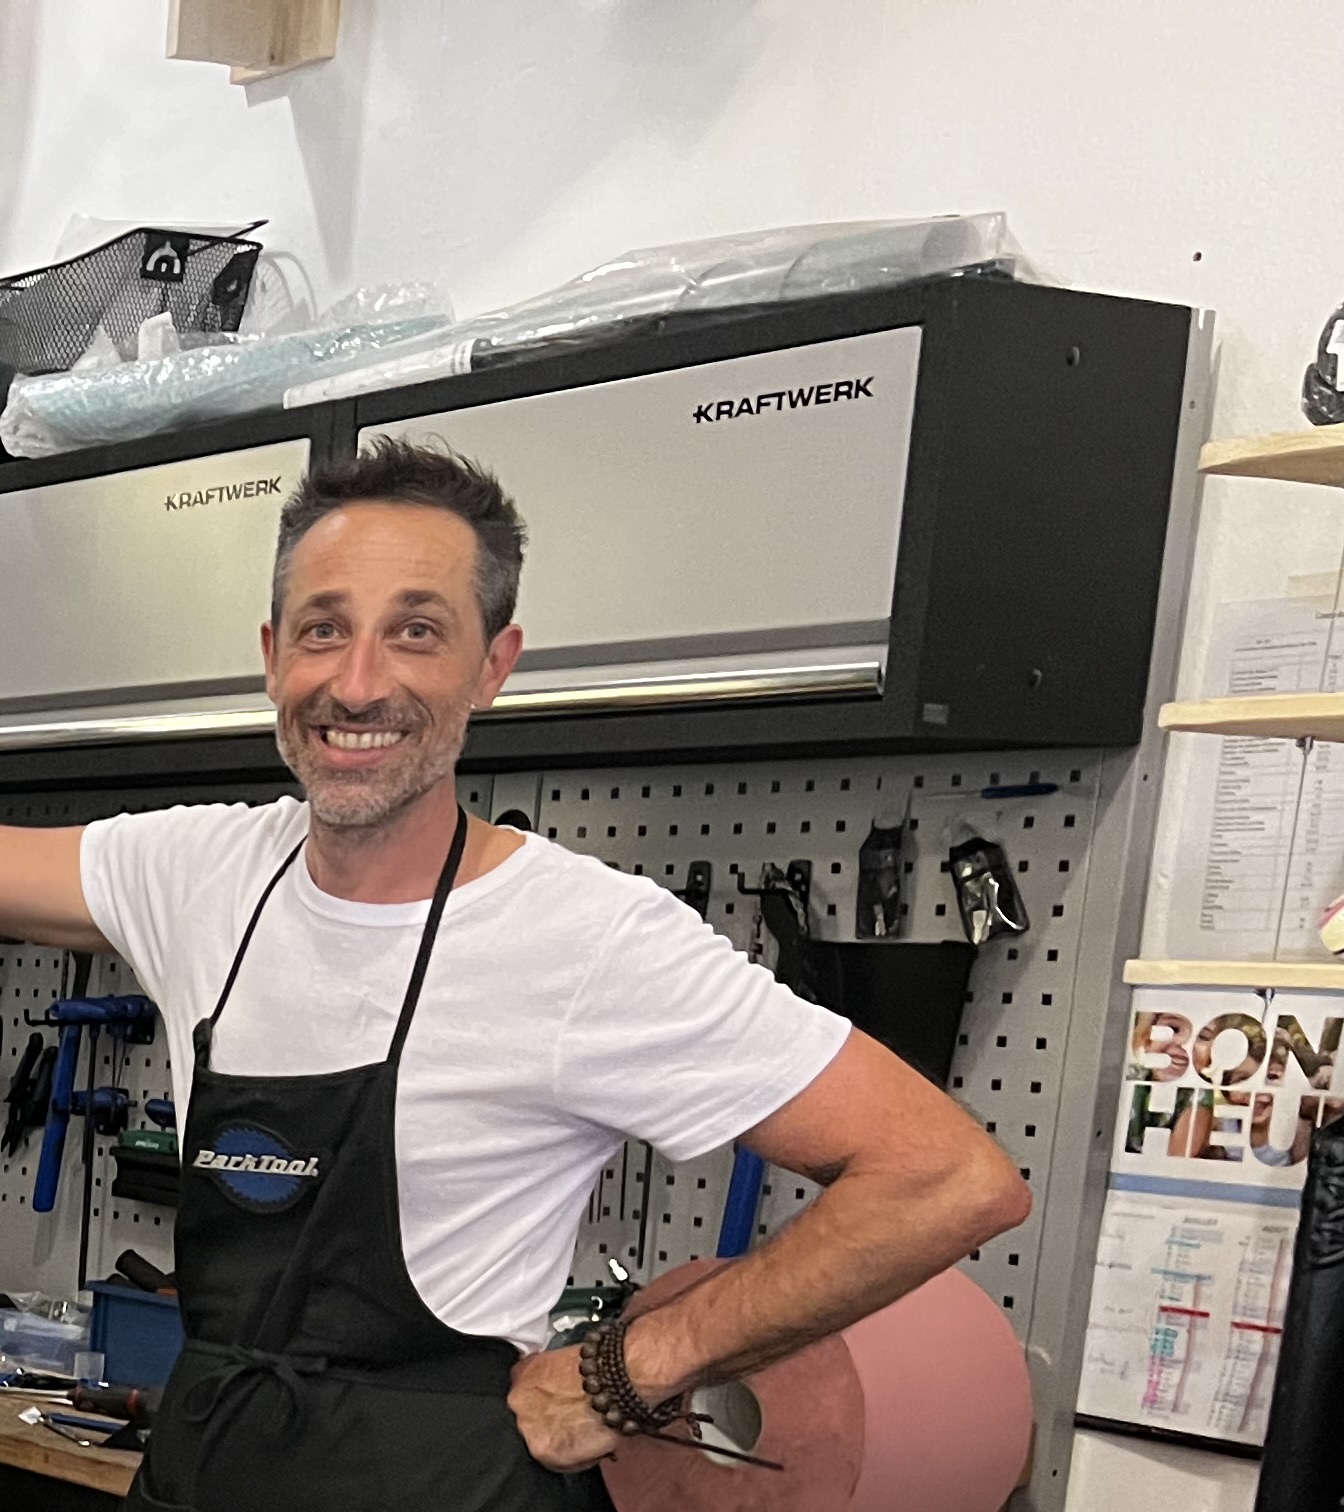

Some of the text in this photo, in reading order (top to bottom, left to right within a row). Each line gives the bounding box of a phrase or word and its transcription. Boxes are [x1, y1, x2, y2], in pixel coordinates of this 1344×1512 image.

[693, 376, 874, 424] KRAFTWERK
[164, 476, 281, 511] KRAFTWERK
[1125, 1011, 1344, 1091] BON
